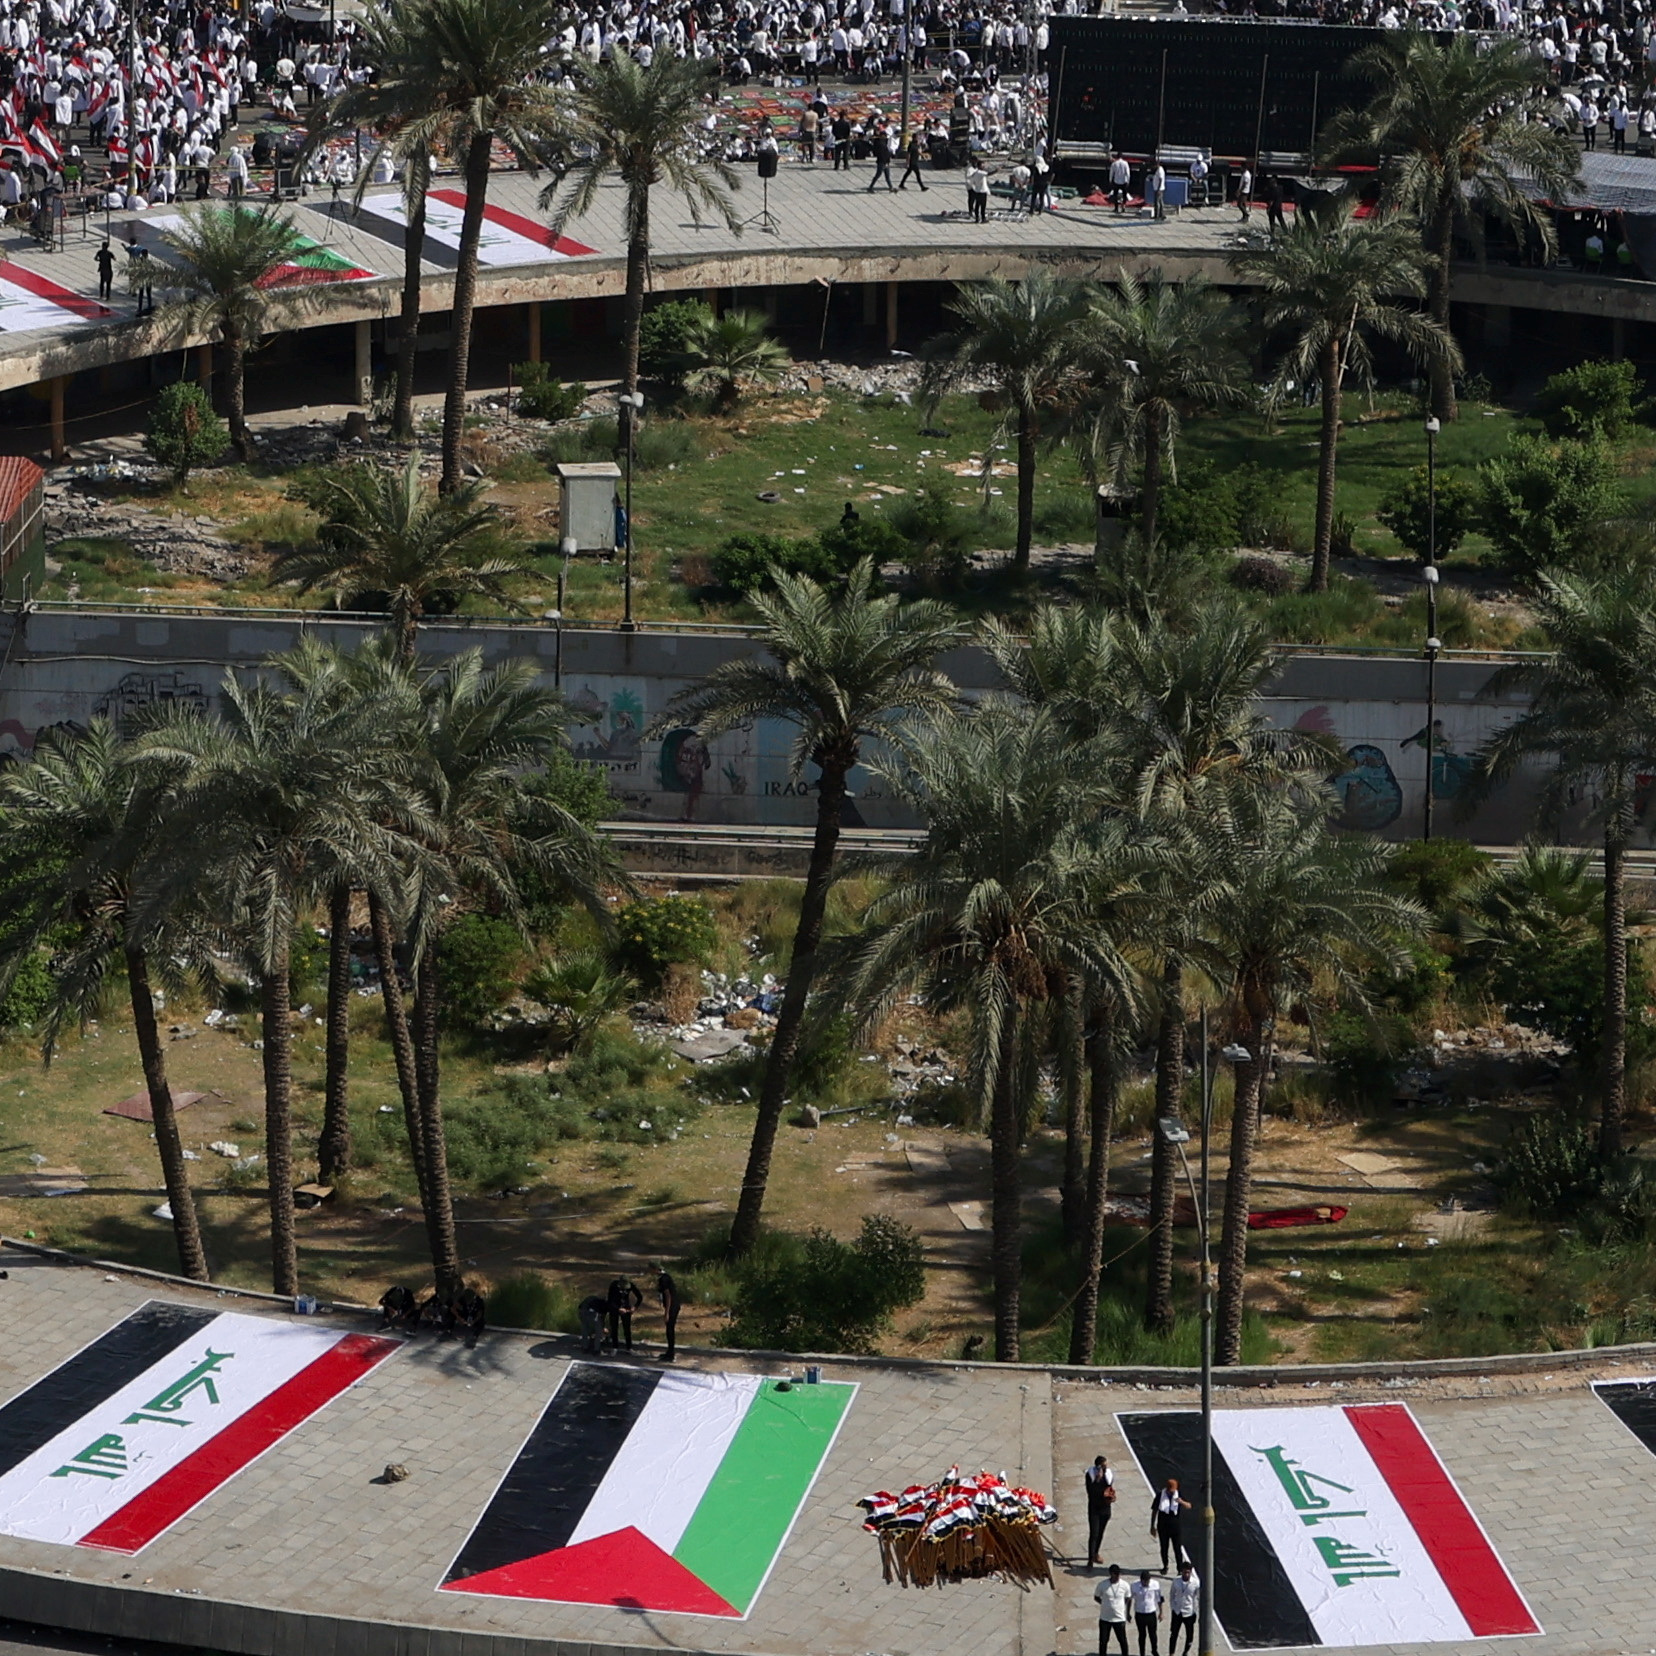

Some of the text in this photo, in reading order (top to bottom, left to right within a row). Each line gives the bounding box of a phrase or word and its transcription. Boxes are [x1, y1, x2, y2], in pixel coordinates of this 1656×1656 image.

[765, 781, 809, 797] IRAQ
[49, 1434, 130, 1480] الله
[1312, 1535, 1402, 1589] الله
